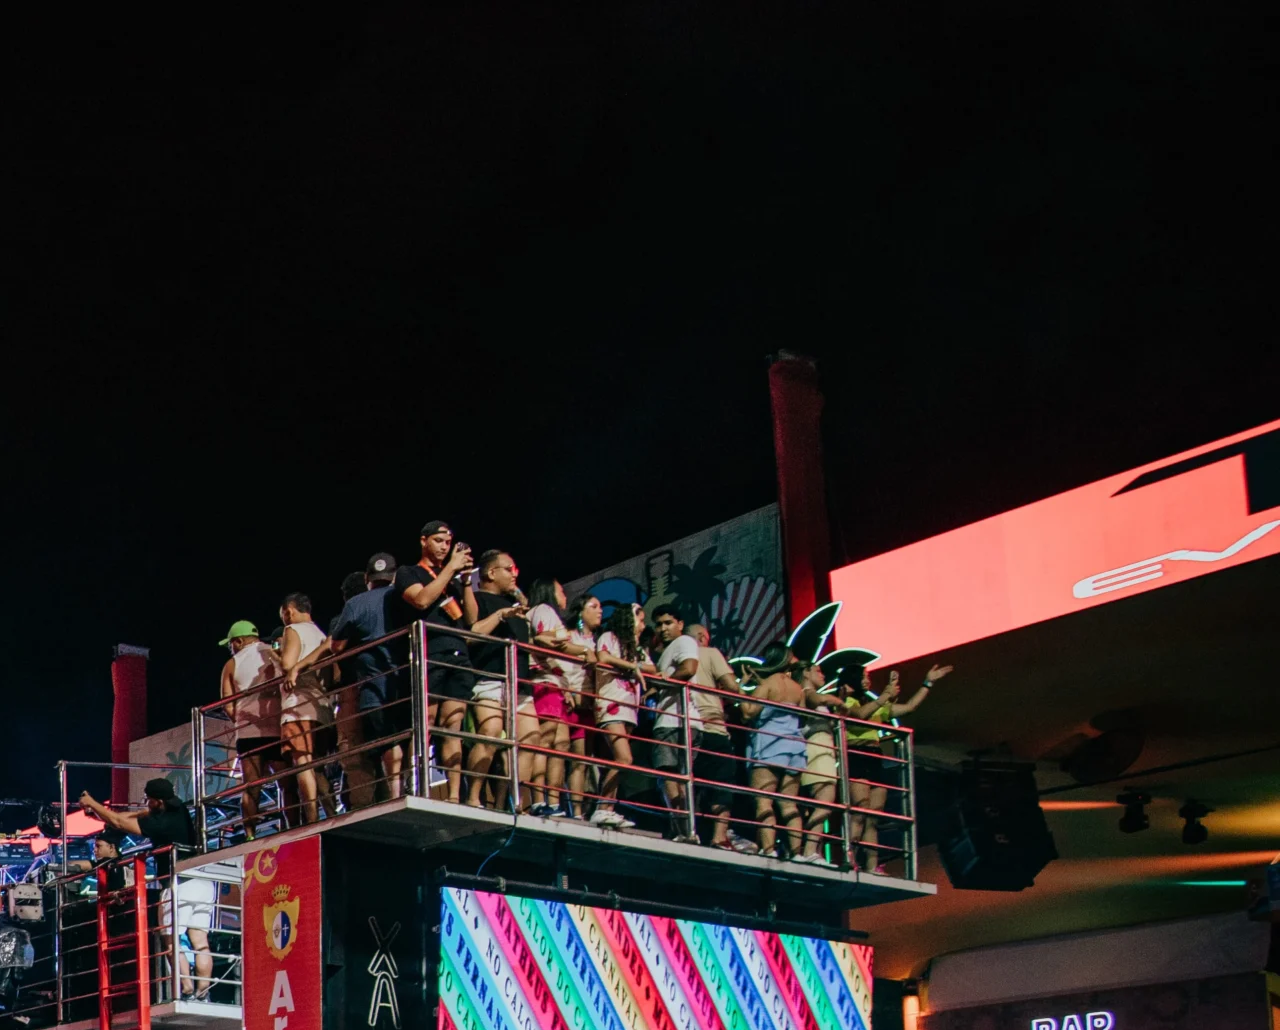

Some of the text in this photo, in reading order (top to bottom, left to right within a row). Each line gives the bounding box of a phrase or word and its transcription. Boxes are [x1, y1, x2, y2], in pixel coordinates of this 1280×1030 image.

[486, 938, 501, 976] NO
[495, 897, 549, 1014] MATHEUS
[519, 896, 553, 972] CALOR
[557, 971, 571, 1005] DO
[605, 909, 643, 987] ANDES
[663, 967, 676, 1001] NO
[666, 917, 713, 1029] MATHEUS
[691, 924, 723, 998] CALOR
[725, 996, 738, 1029] DO
[758, 962, 770, 994] DO
[787, 935, 828, 1023] ARNAVAL
